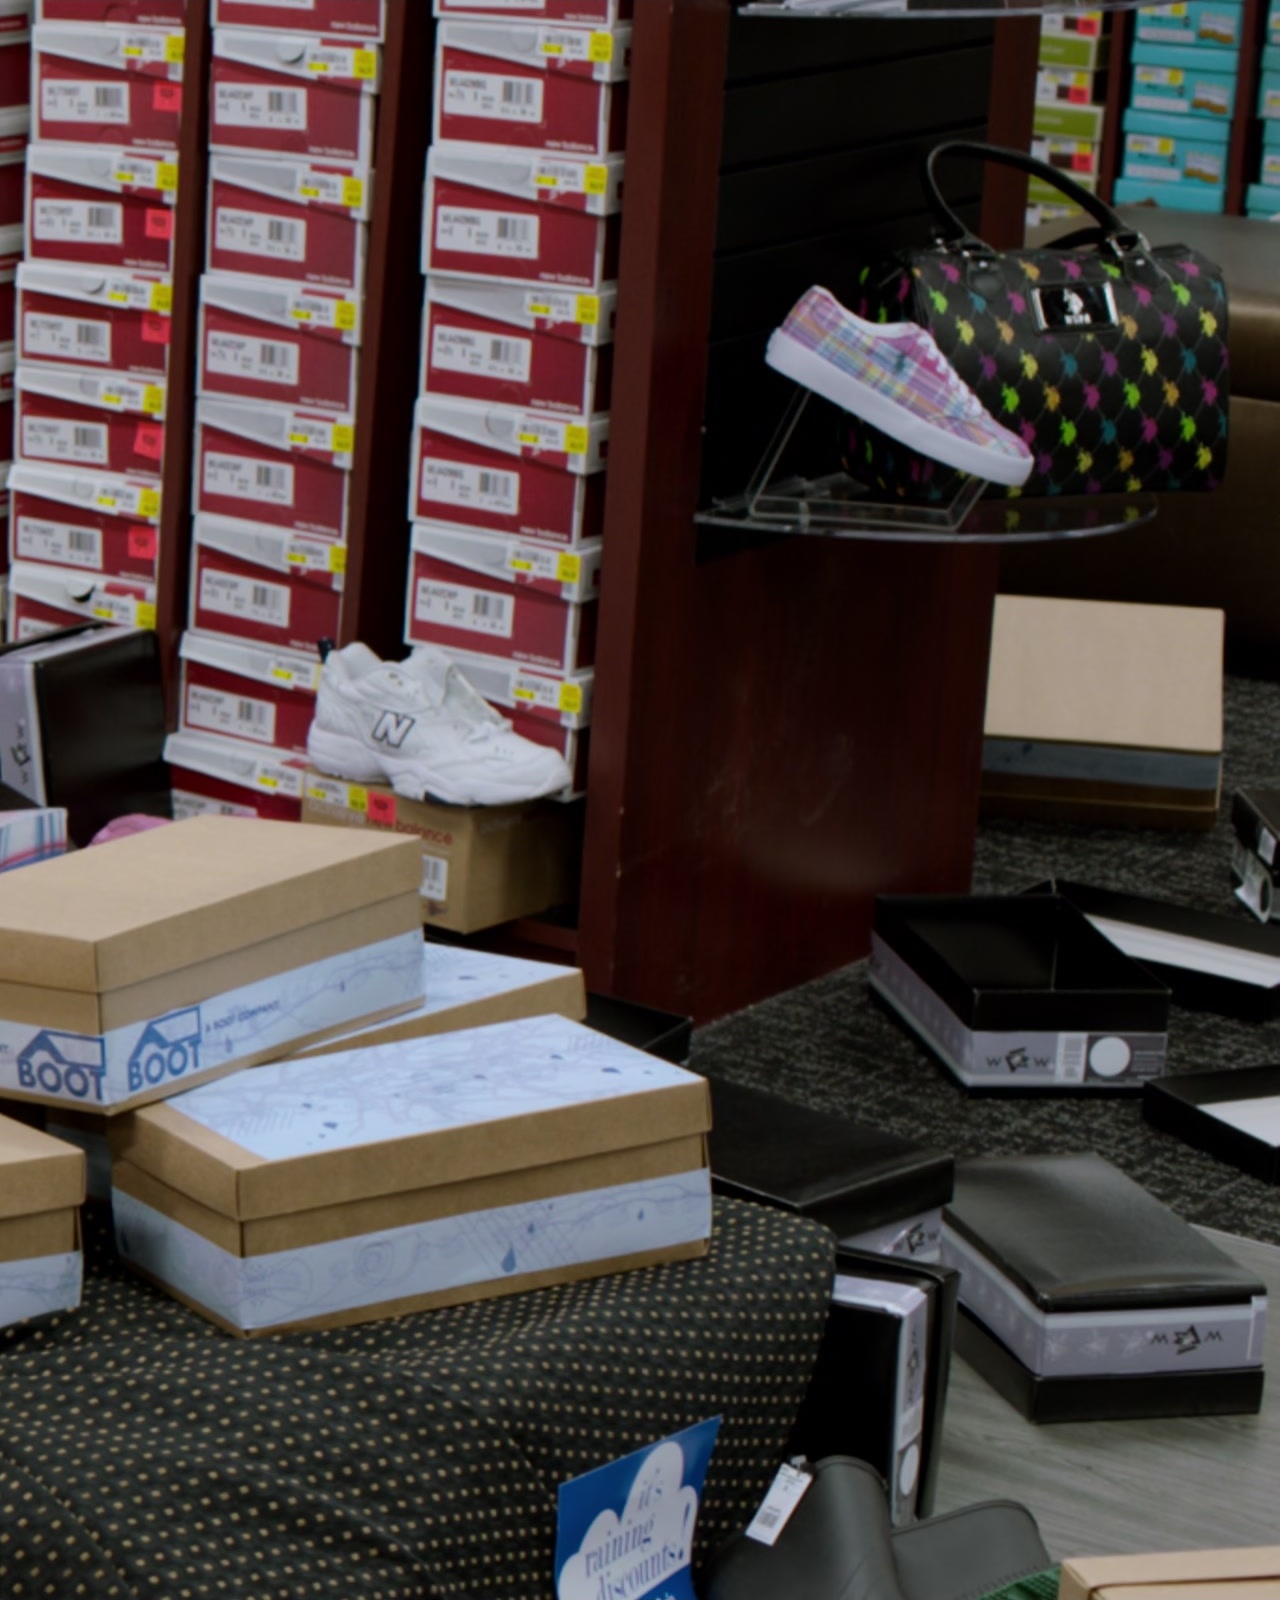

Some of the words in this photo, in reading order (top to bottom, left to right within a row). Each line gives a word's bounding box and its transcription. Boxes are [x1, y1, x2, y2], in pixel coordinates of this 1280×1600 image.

[371, 710, 416, 749] N
[17, 1054, 106, 1101] BOOT
[128, 1039, 202, 1092] BOOT
[585, 1512, 656, 1579] raining
